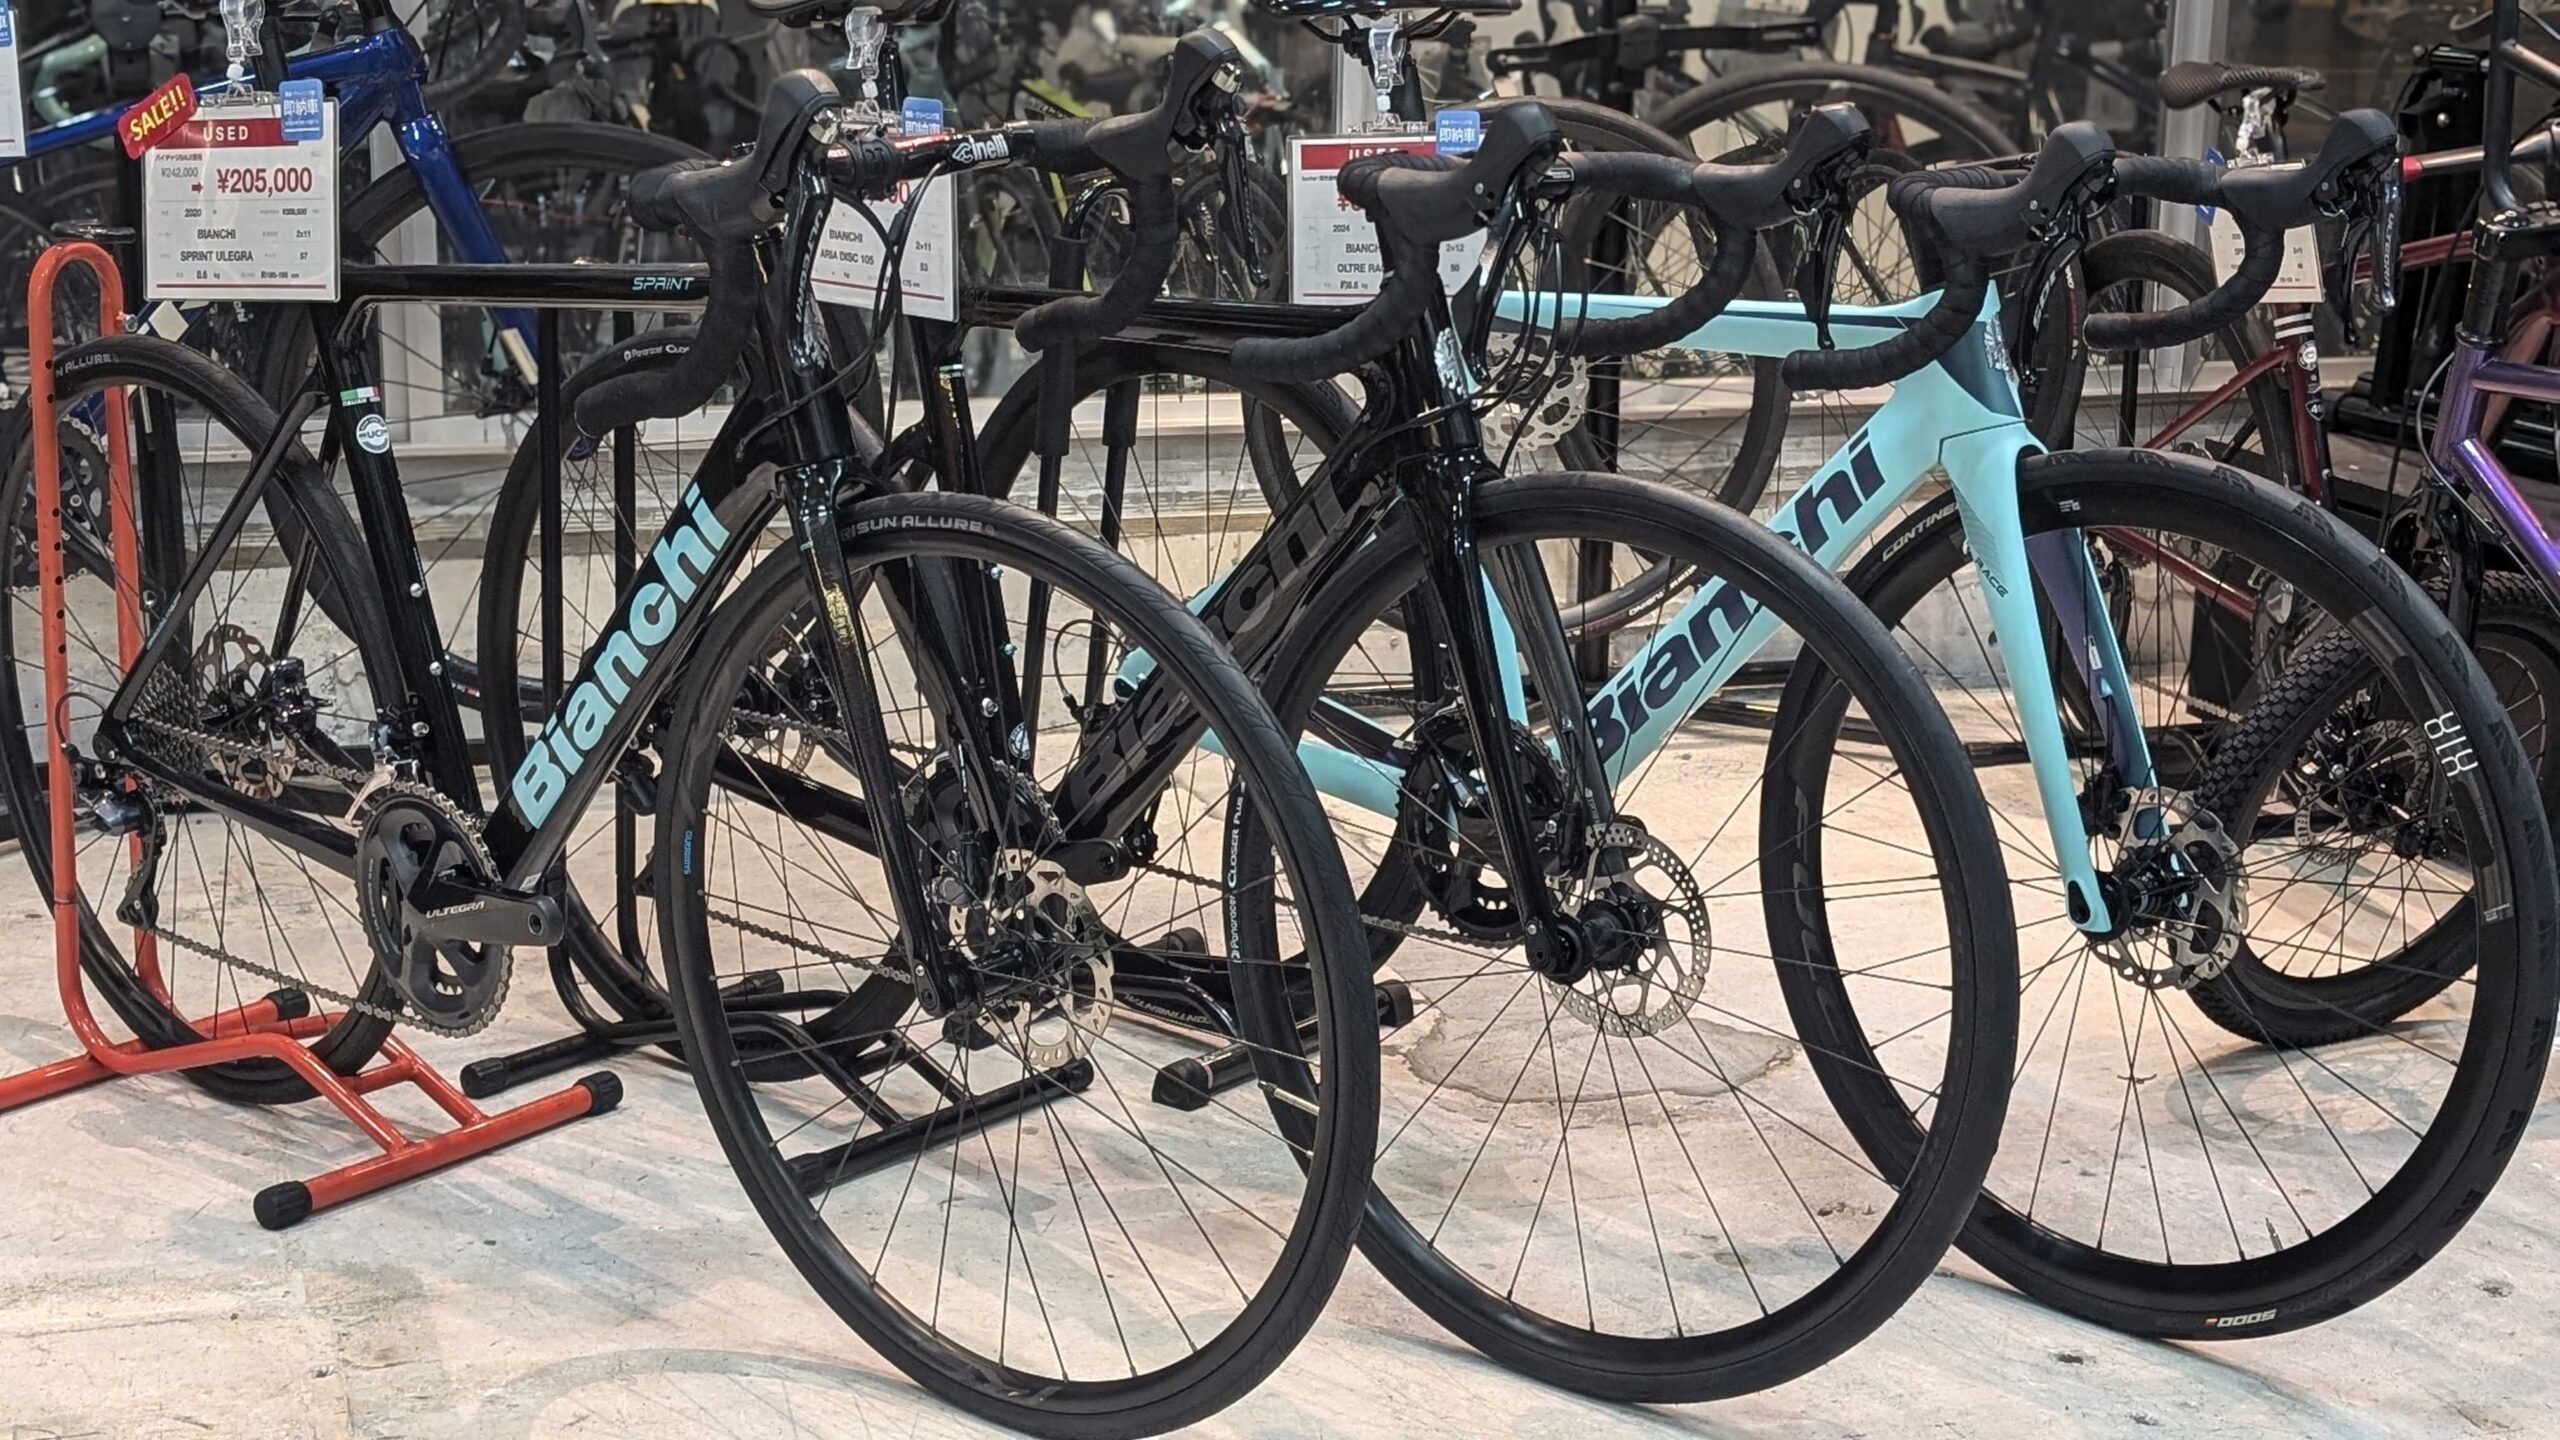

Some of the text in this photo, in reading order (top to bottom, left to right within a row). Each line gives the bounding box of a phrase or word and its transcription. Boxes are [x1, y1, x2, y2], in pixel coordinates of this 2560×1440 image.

[129, 84, 188, 142] SALE!!
[202, 125, 249, 142] USED
[161, 166, 199, 178] ¥242,000
[216, 167, 312, 197] ¥205,000
[196, 228, 237, 240] BIANCHI
[828, 228, 864, 245] BIANCHI
[1332, 224, 1351, 234] 2024
[180, 250, 214, 262] SPRINT
[216, 250, 254, 262] ULEGRA
[819, 247, 875, 266] ARIA DISC 105
[1345, 243, 1382, 254] BIANCH
[1337, 263, 1366, 274] OLTRE
[631, 276, 696, 291] SPRINT
[64, 353, 113, 375] ALLURE
[839, 515, 983, 542] RISUN ALLURE
[1882, 502, 1959, 563] CONTINE
[1586, 427, 1887, 766] Bianhi
[511, 482, 731, 830] Bianchi
[425, 901, 486, 919] ULTEGRA
[2216, 1308, 2278, 1328] 5000
